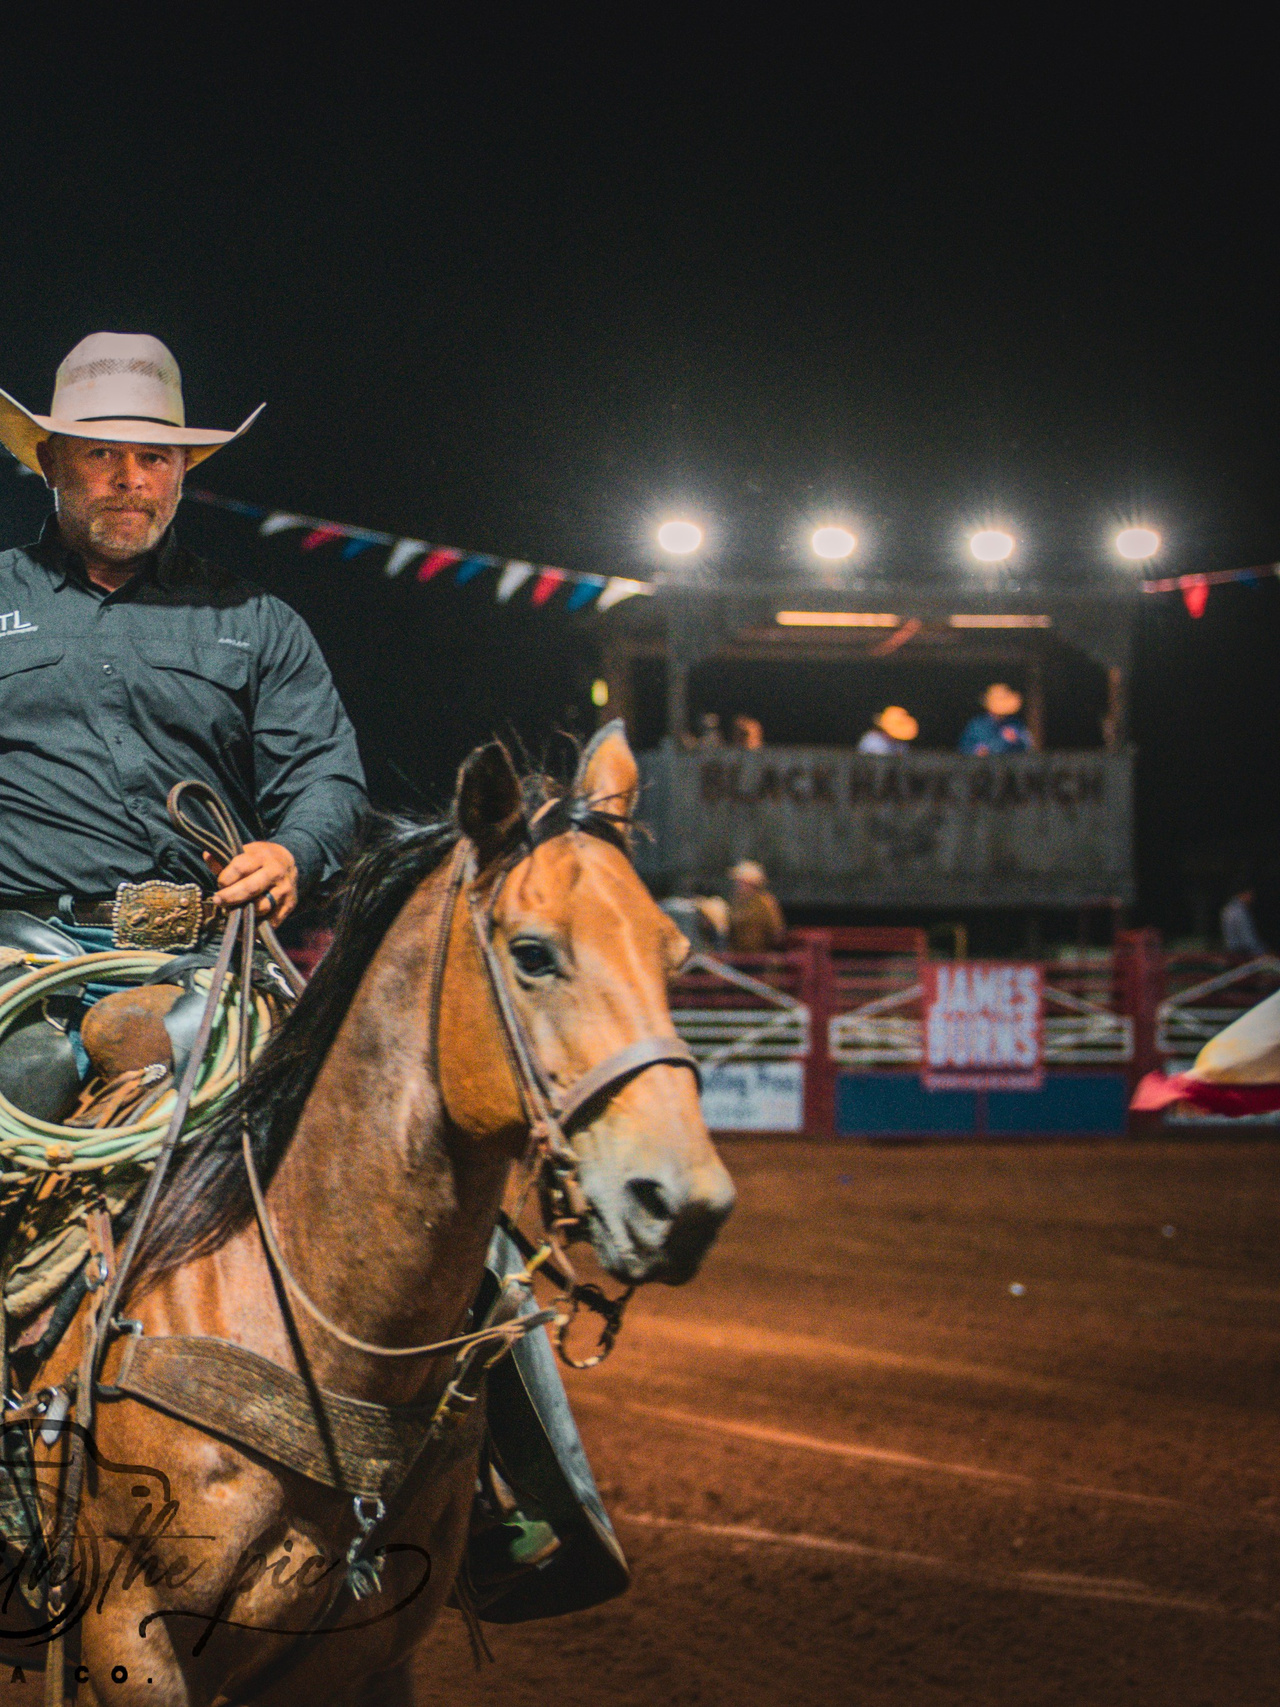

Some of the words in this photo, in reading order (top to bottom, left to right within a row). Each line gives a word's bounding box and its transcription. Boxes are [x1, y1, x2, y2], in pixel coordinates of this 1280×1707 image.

[700, 761, 830, 803] BLACK
[850, 762, 954, 803] HAWK
[970, 763, 1106, 805] RANCH
[932, 966, 1039, 1014] JAMES
[928, 1014, 1039, 1066] BURNS
